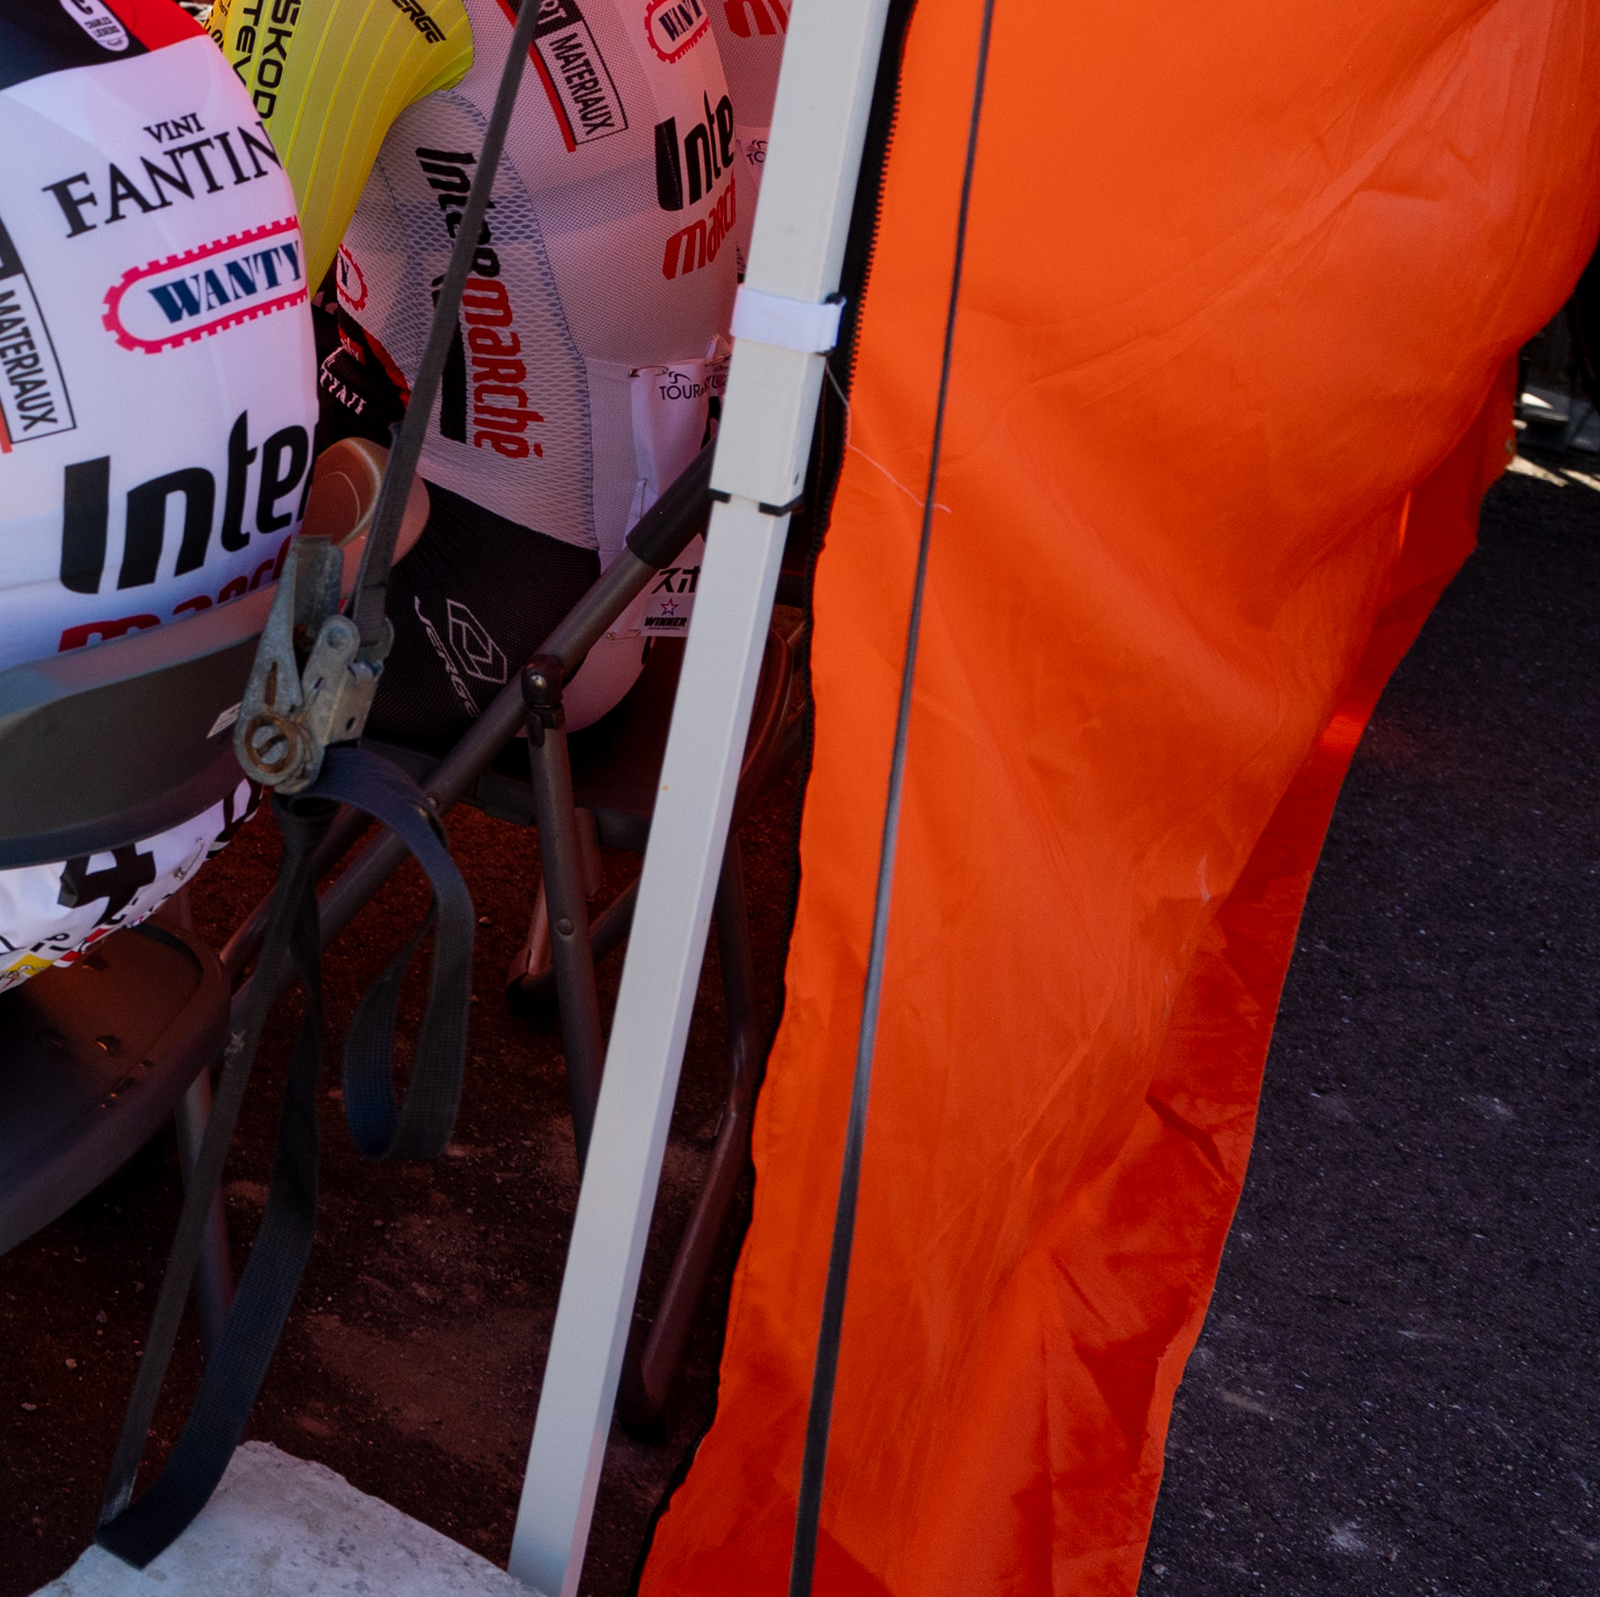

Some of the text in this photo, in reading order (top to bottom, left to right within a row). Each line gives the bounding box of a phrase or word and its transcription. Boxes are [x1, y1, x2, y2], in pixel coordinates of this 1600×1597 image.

[549, 31, 616, 137] MATERIAUX
[143, 112, 206, 144] VINI
[147, 239, 303, 324] WANTY
[644, 616, 688, 628] WINNER
